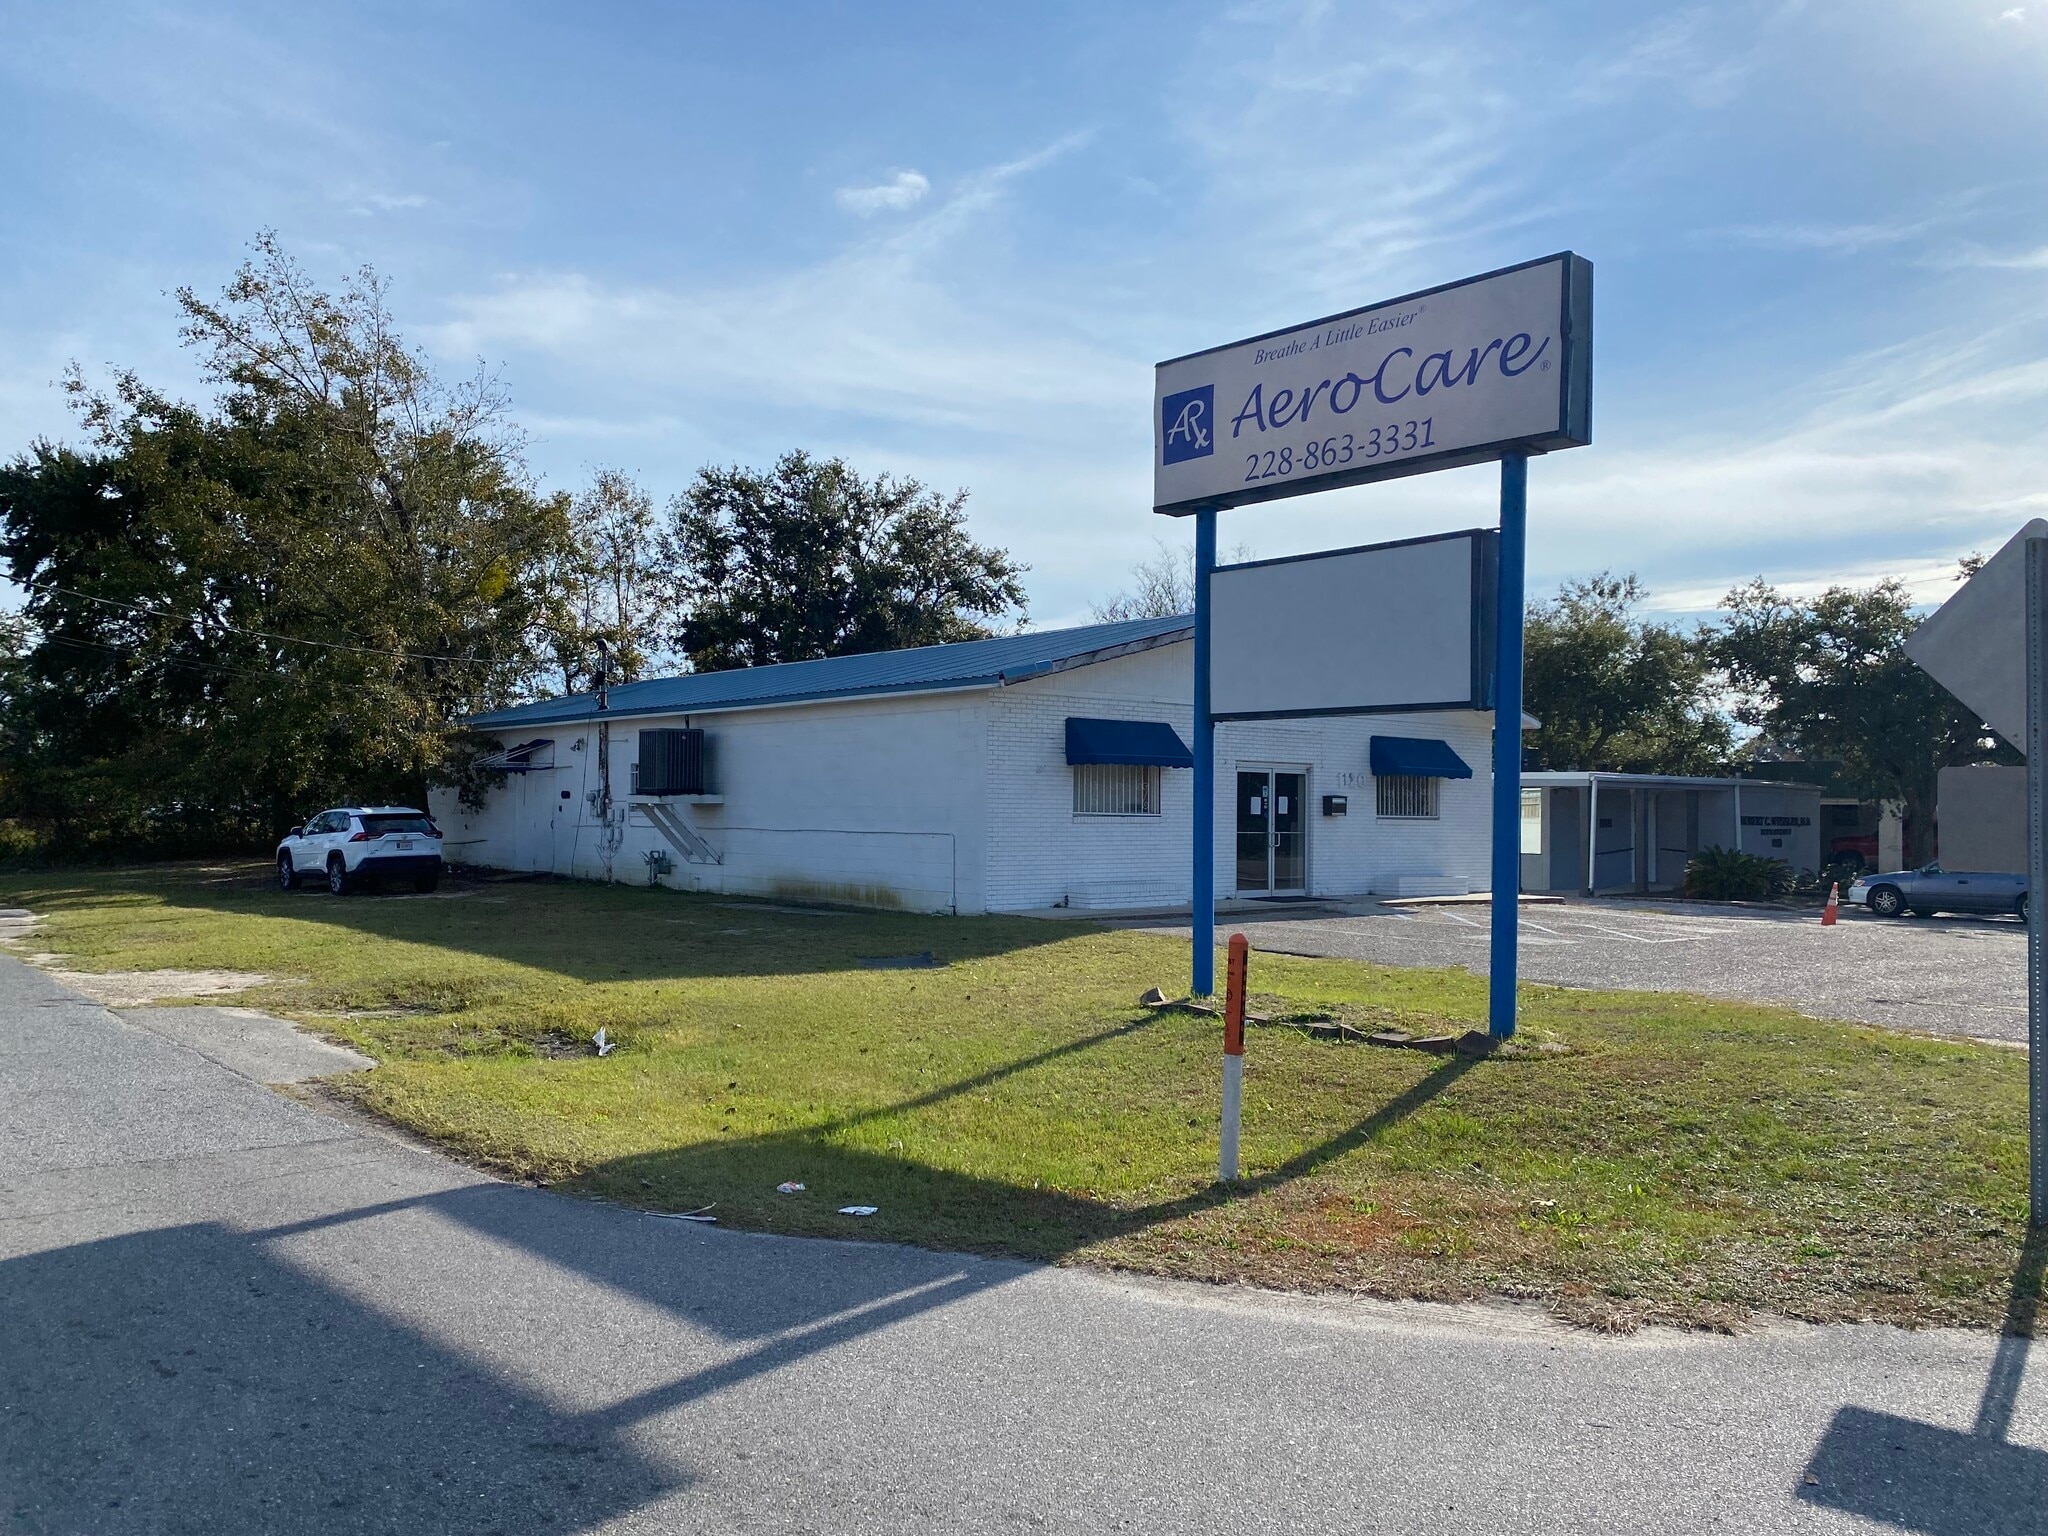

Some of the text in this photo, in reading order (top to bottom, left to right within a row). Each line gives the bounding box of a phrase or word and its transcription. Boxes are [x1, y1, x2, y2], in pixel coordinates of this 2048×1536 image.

[1254, 336, 1307, 365] Breathe
[1310, 334, 1321, 351] A
[1325, 324, 1363, 346] Little
[1231, 333, 1550, 438] AeroCare
[1244, 416, 1435, 482] 228-863-3331
